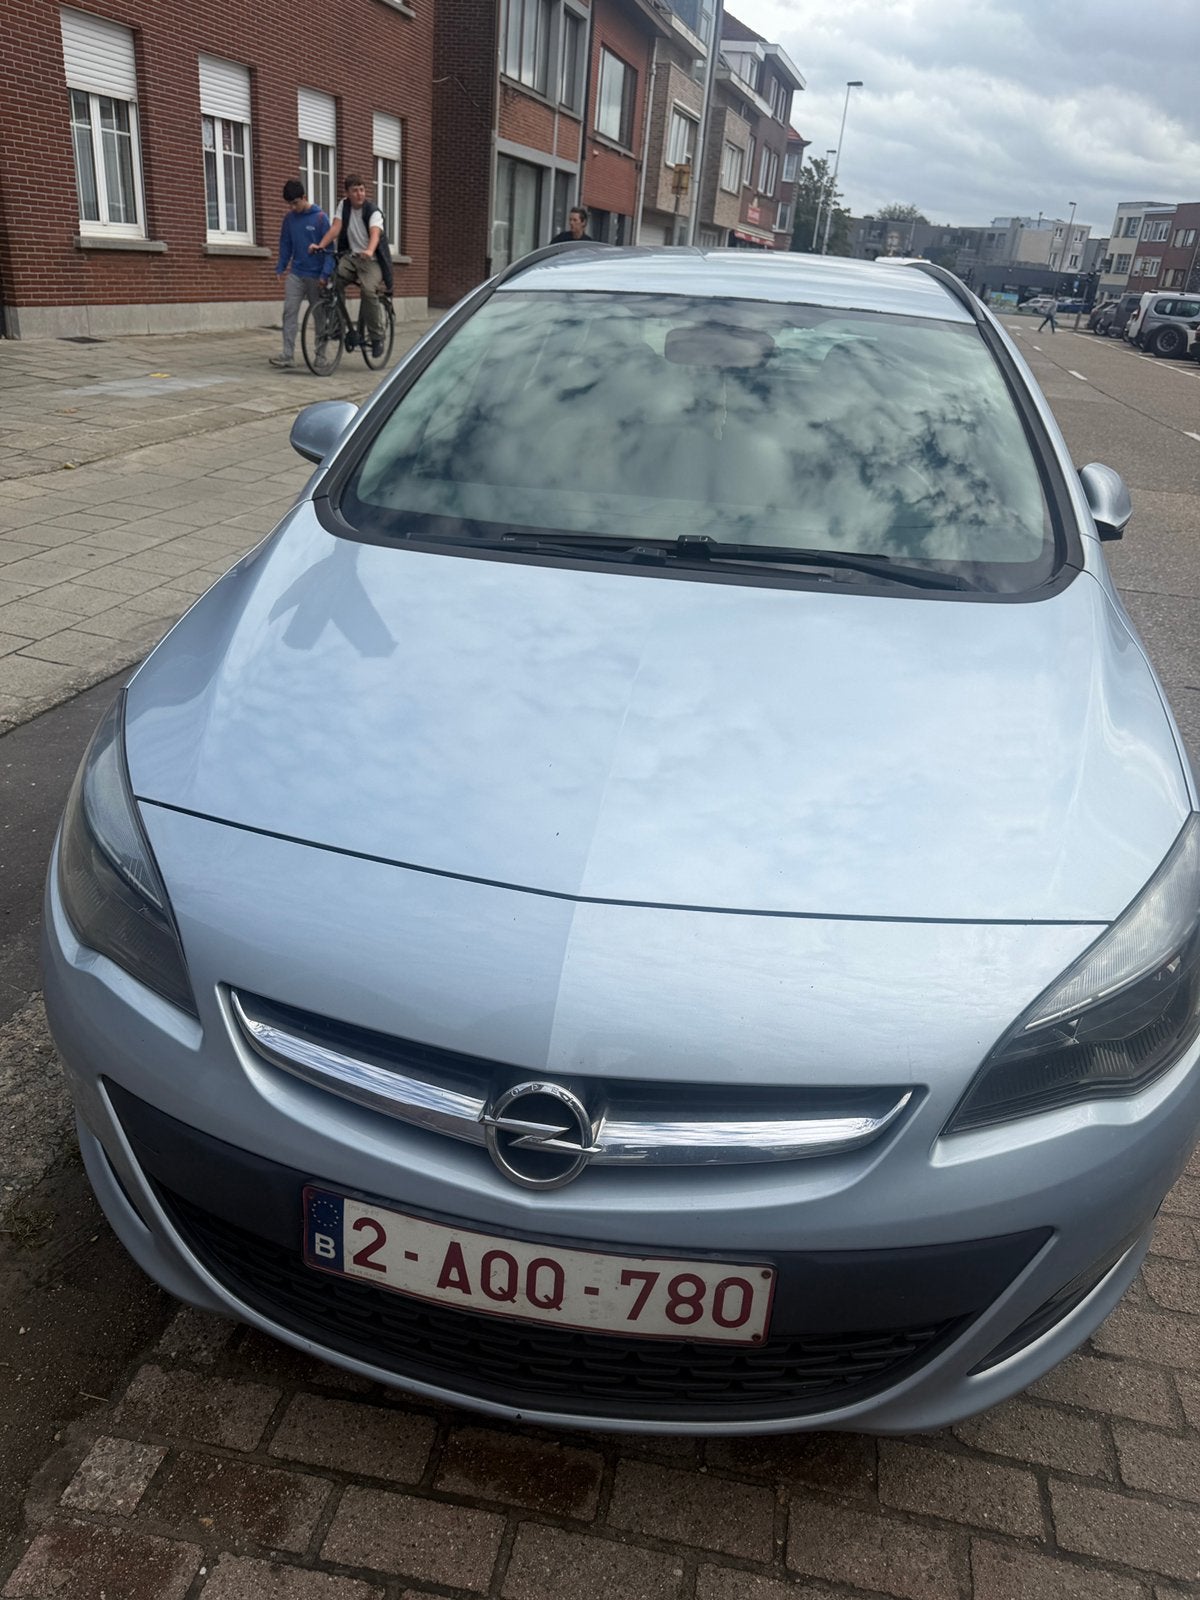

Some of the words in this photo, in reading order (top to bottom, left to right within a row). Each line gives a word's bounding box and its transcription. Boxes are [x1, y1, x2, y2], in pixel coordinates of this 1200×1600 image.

[511, 1083, 575, 1107] OPEL
[314, 1232, 336, 1260] B
[352, 1216, 754, 1329] 2-AQQ-780
